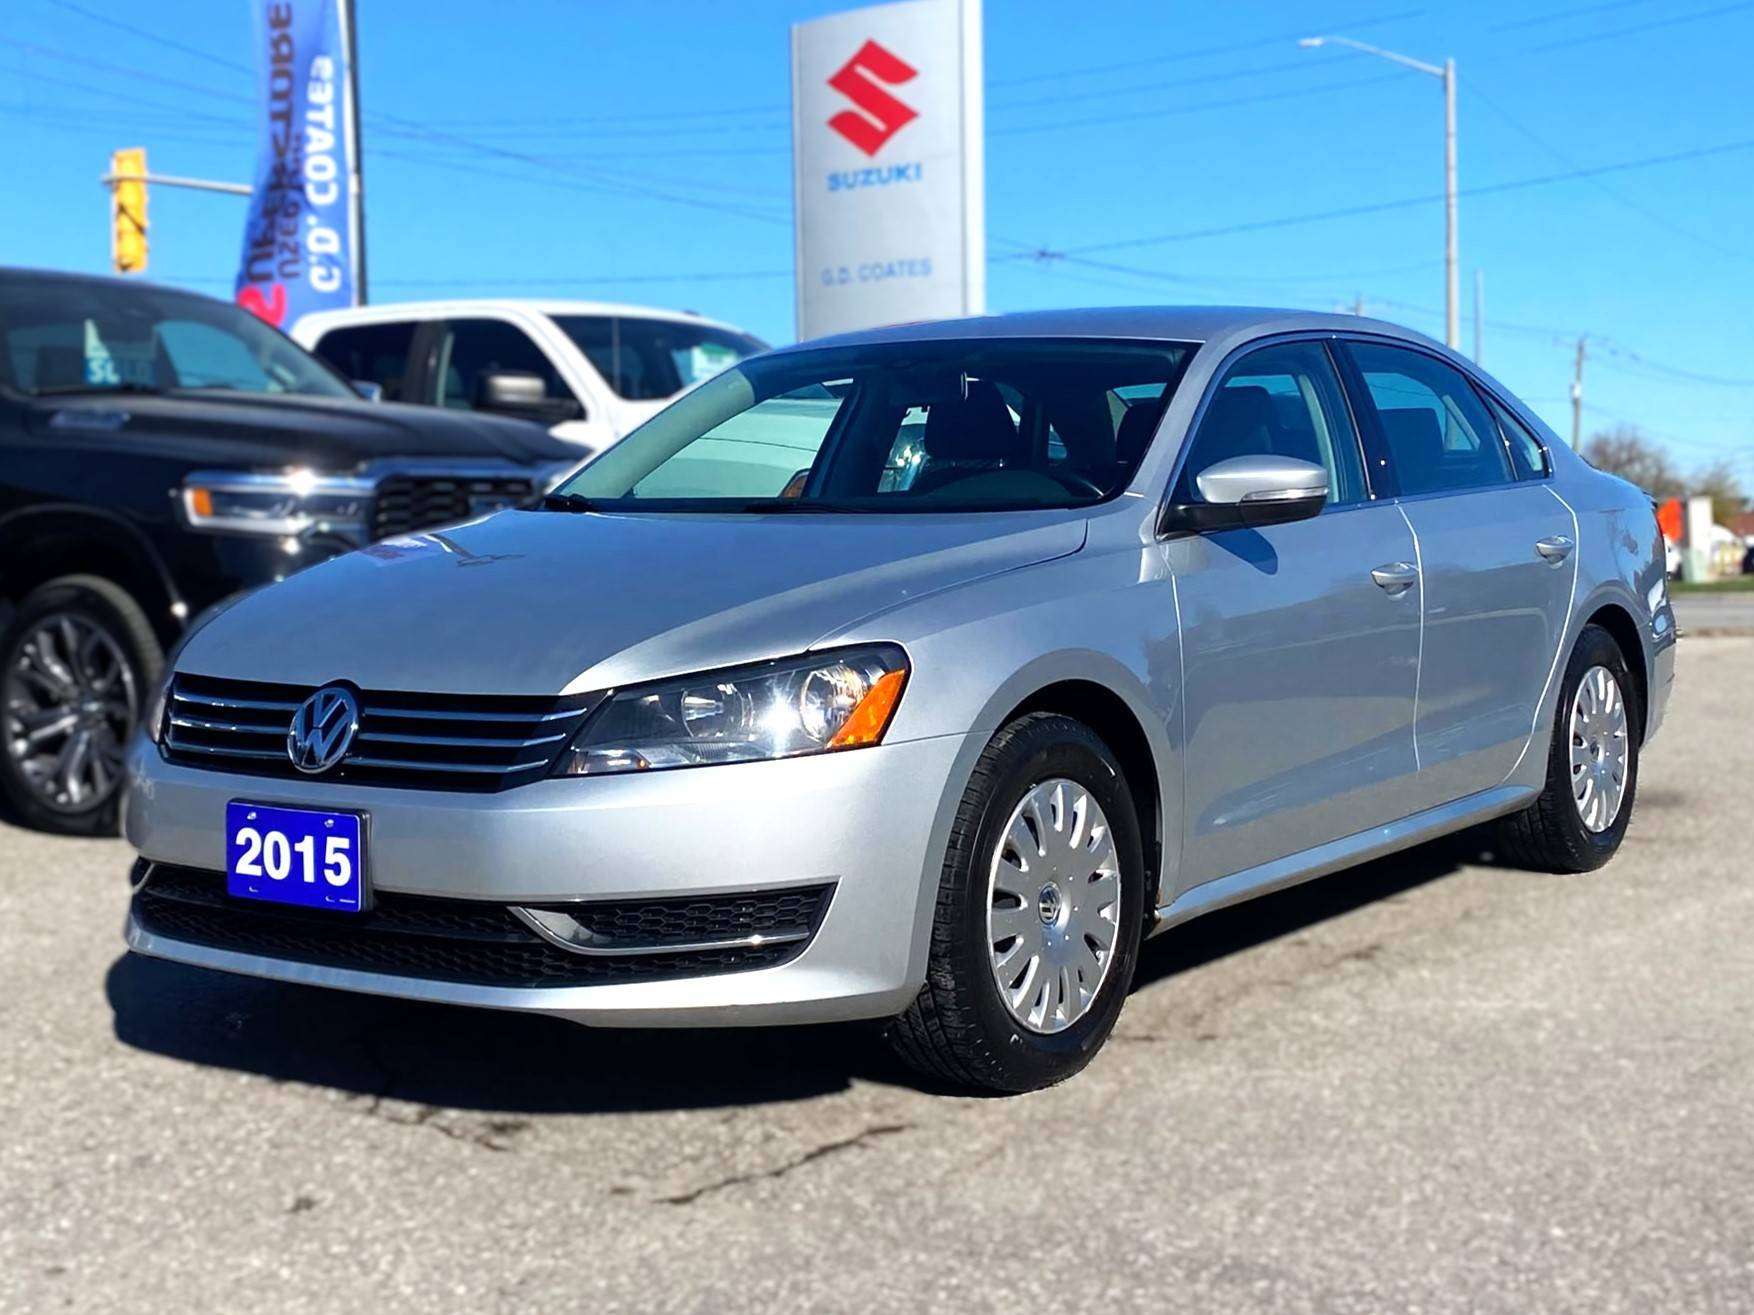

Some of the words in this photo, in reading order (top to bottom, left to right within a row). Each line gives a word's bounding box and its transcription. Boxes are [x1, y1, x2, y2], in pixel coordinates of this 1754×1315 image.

[825, 162, 923, 192] SUZUKI
[821, 265, 855, 287] G.D.
[857, 257, 932, 284] COATES
[234, 827, 352, 887] 2015
